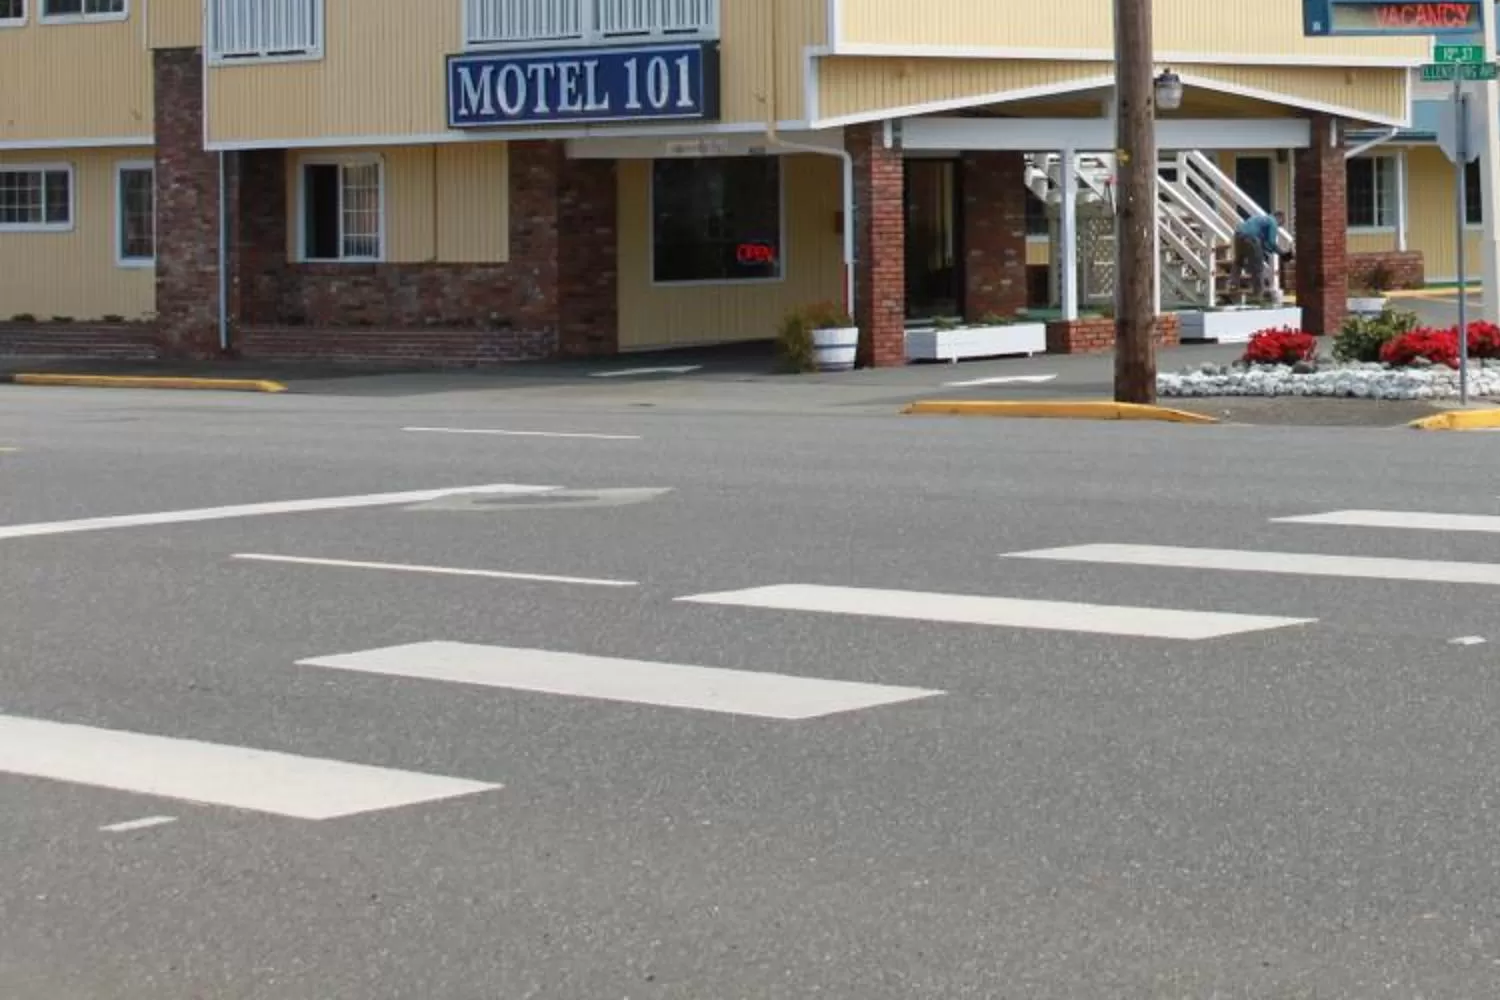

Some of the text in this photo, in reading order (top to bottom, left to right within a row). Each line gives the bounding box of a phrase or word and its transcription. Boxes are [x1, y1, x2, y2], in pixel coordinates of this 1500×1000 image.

[1374, 2, 1472, 28] VACANCY
[456, 54, 694, 117] MOTEL 101
